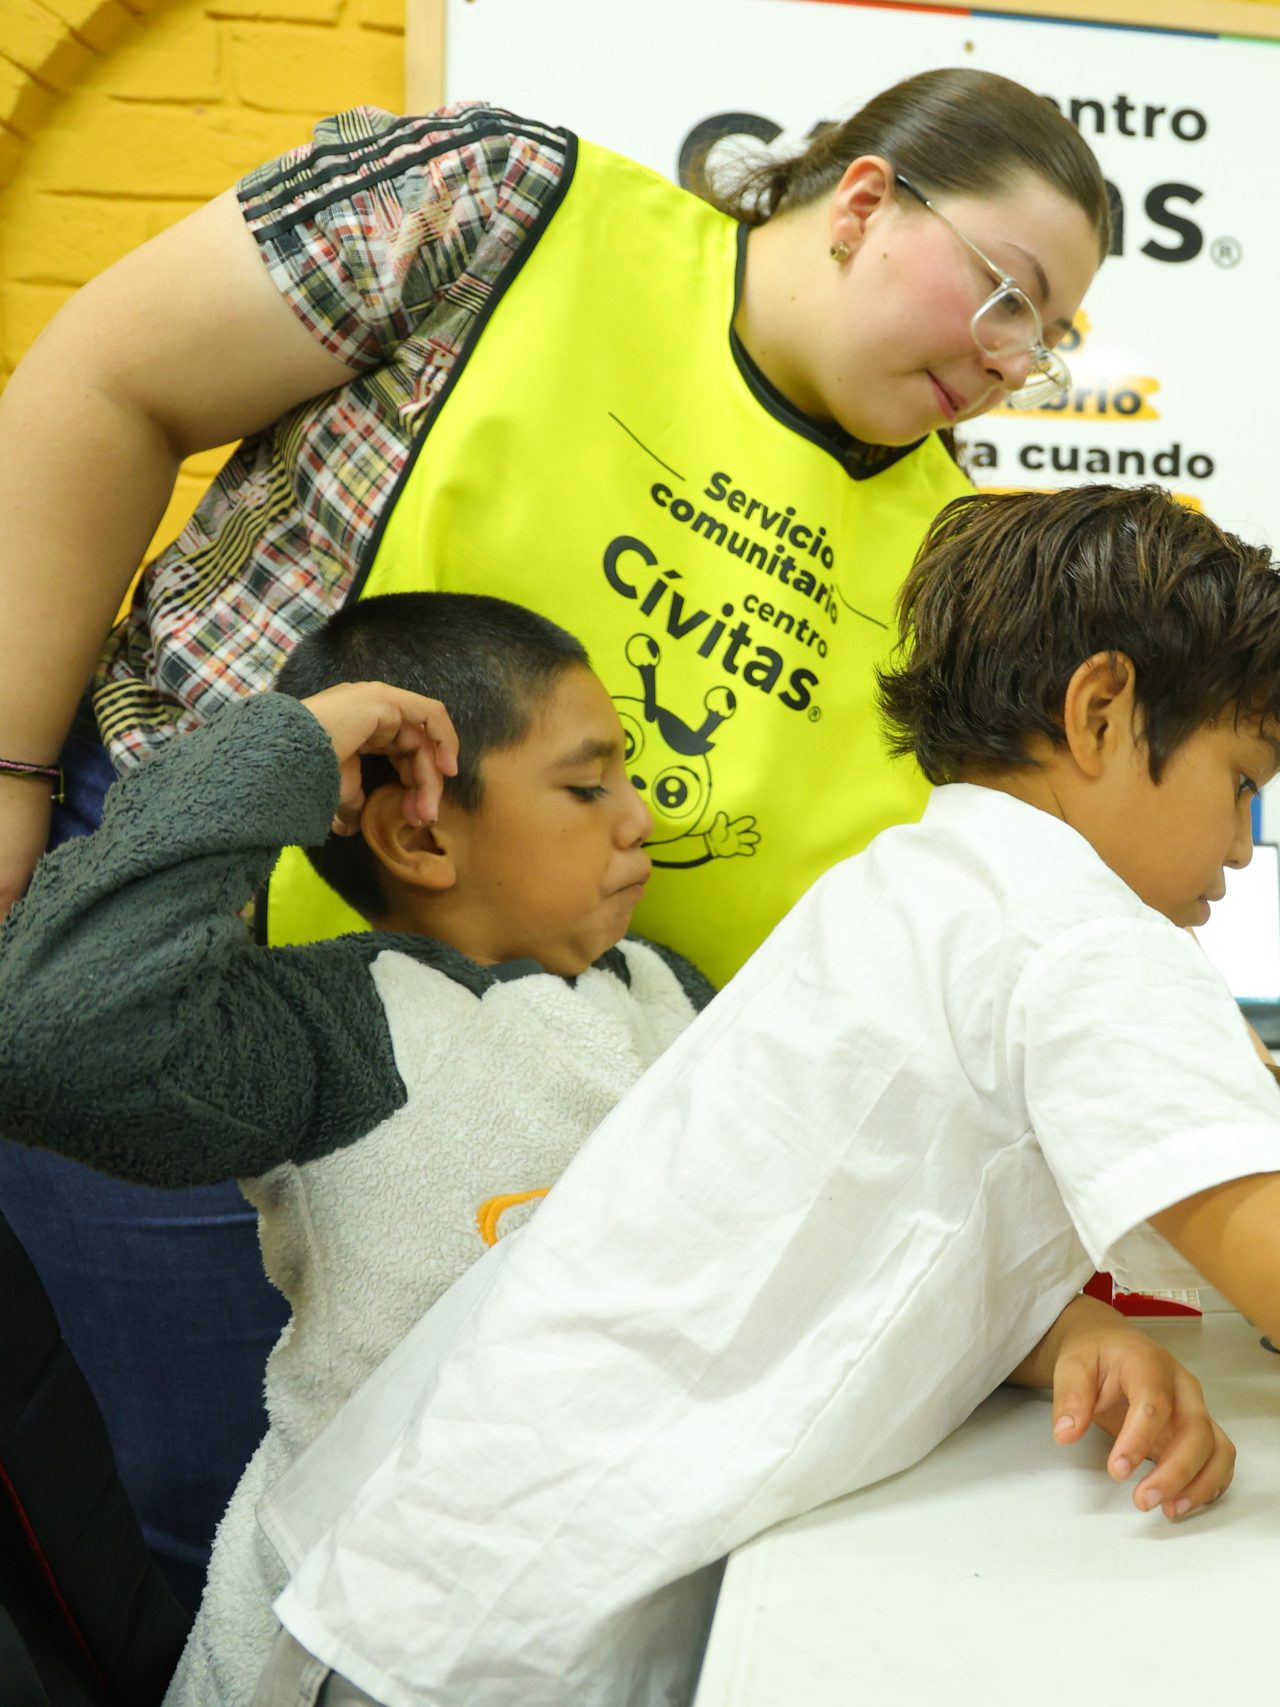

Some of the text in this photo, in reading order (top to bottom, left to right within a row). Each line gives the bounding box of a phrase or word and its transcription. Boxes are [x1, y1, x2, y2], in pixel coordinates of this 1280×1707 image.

[1043, 95, 1207, 141] ntro
[1018, 443, 1215, 479] cuando
[650, 482, 838, 625] comunitario
[703, 472, 834, 570] Servicio
[743, 594, 828, 659] centro
